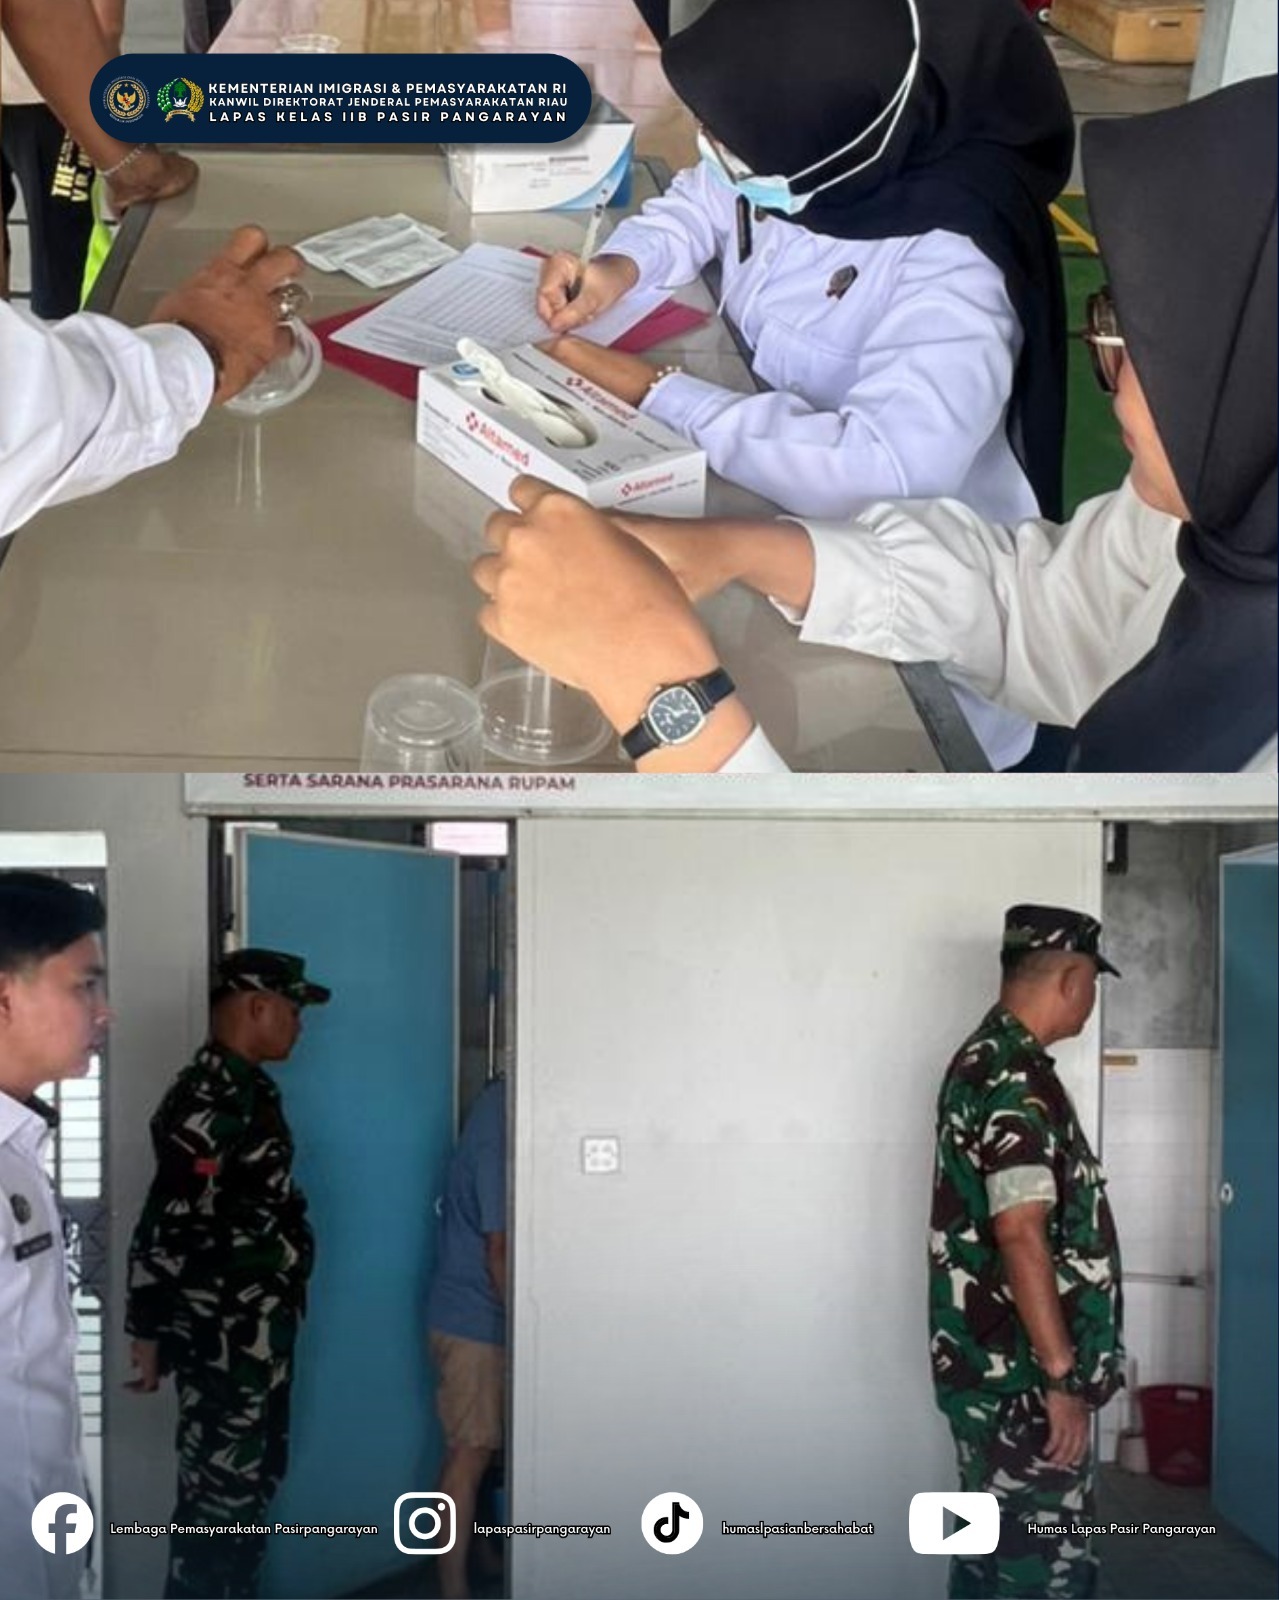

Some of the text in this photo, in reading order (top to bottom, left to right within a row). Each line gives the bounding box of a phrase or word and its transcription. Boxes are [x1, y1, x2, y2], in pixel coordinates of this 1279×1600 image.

[244, 773, 576, 791] SERTA SARANA PRASARANA RUPAM
